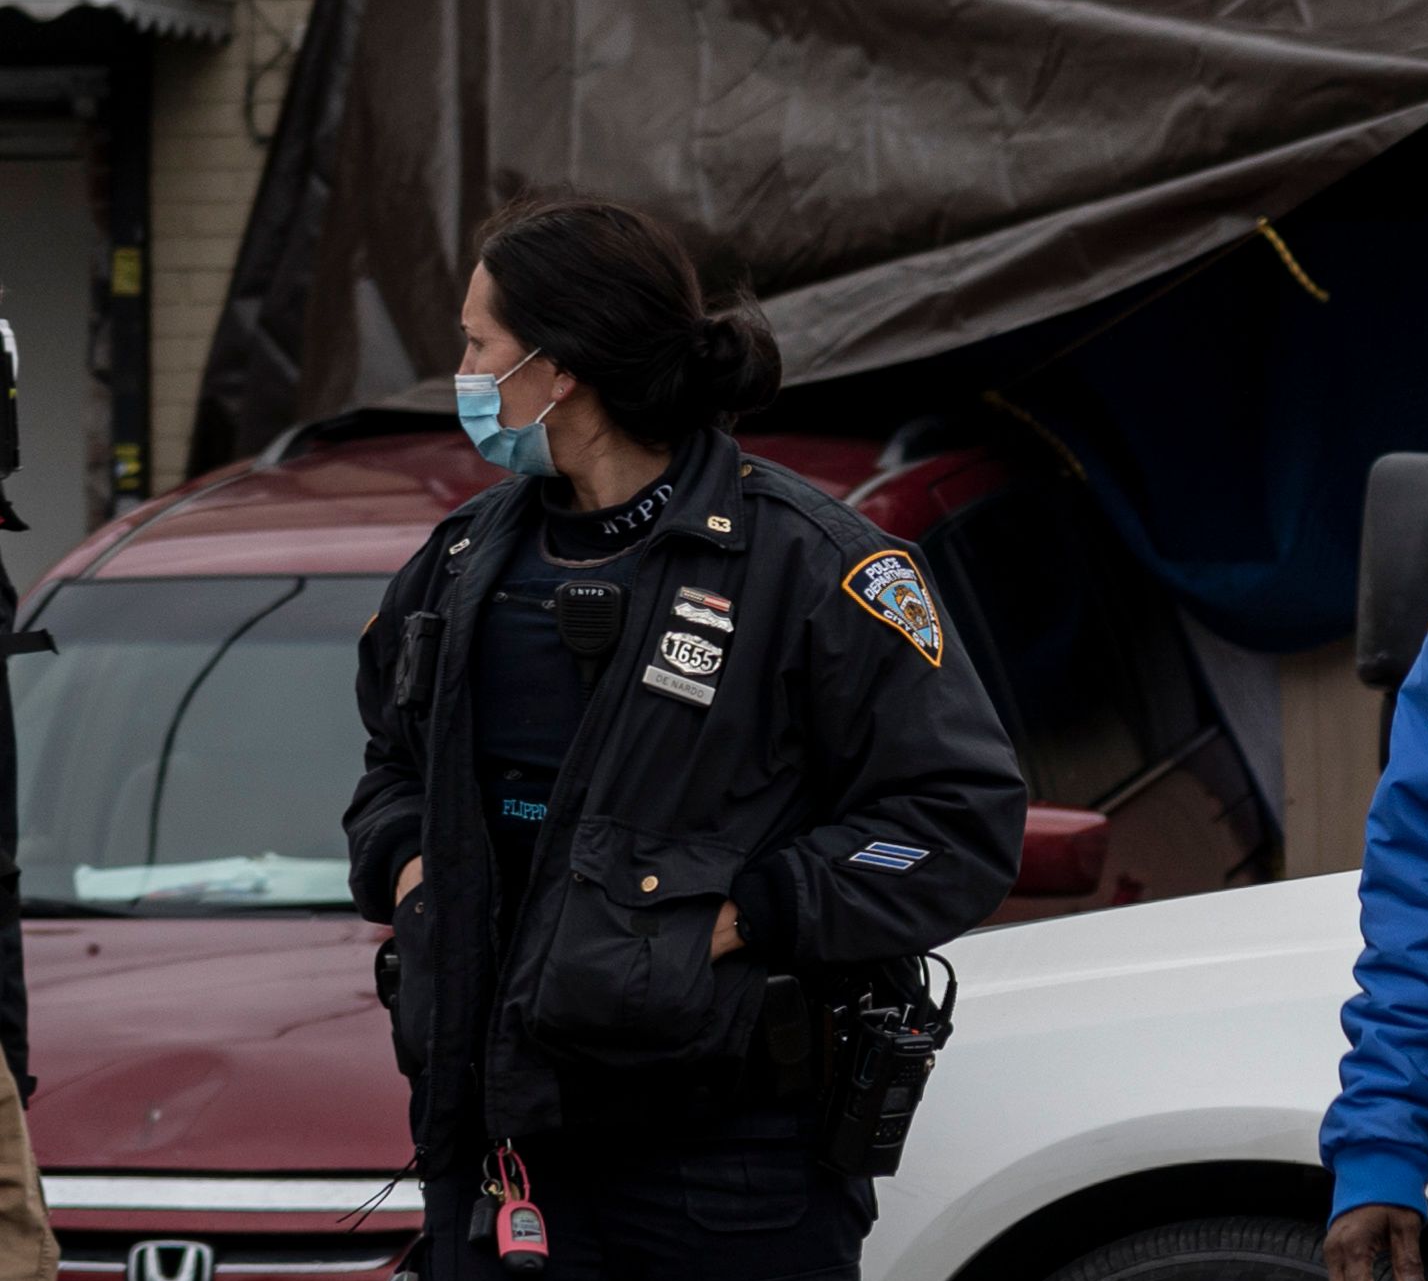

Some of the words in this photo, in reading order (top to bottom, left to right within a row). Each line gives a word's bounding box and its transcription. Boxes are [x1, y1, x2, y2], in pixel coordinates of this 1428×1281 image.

[707, 515, 732, 534] 63
[865, 557, 901, 579] POLICE
[577, 587, 605, 597] NYPD
[883, 610, 911, 632] CITY
[671, 641, 713, 671] 1655
[655, 674, 670, 686] DE
[670, 679, 705, 699] NARDO
